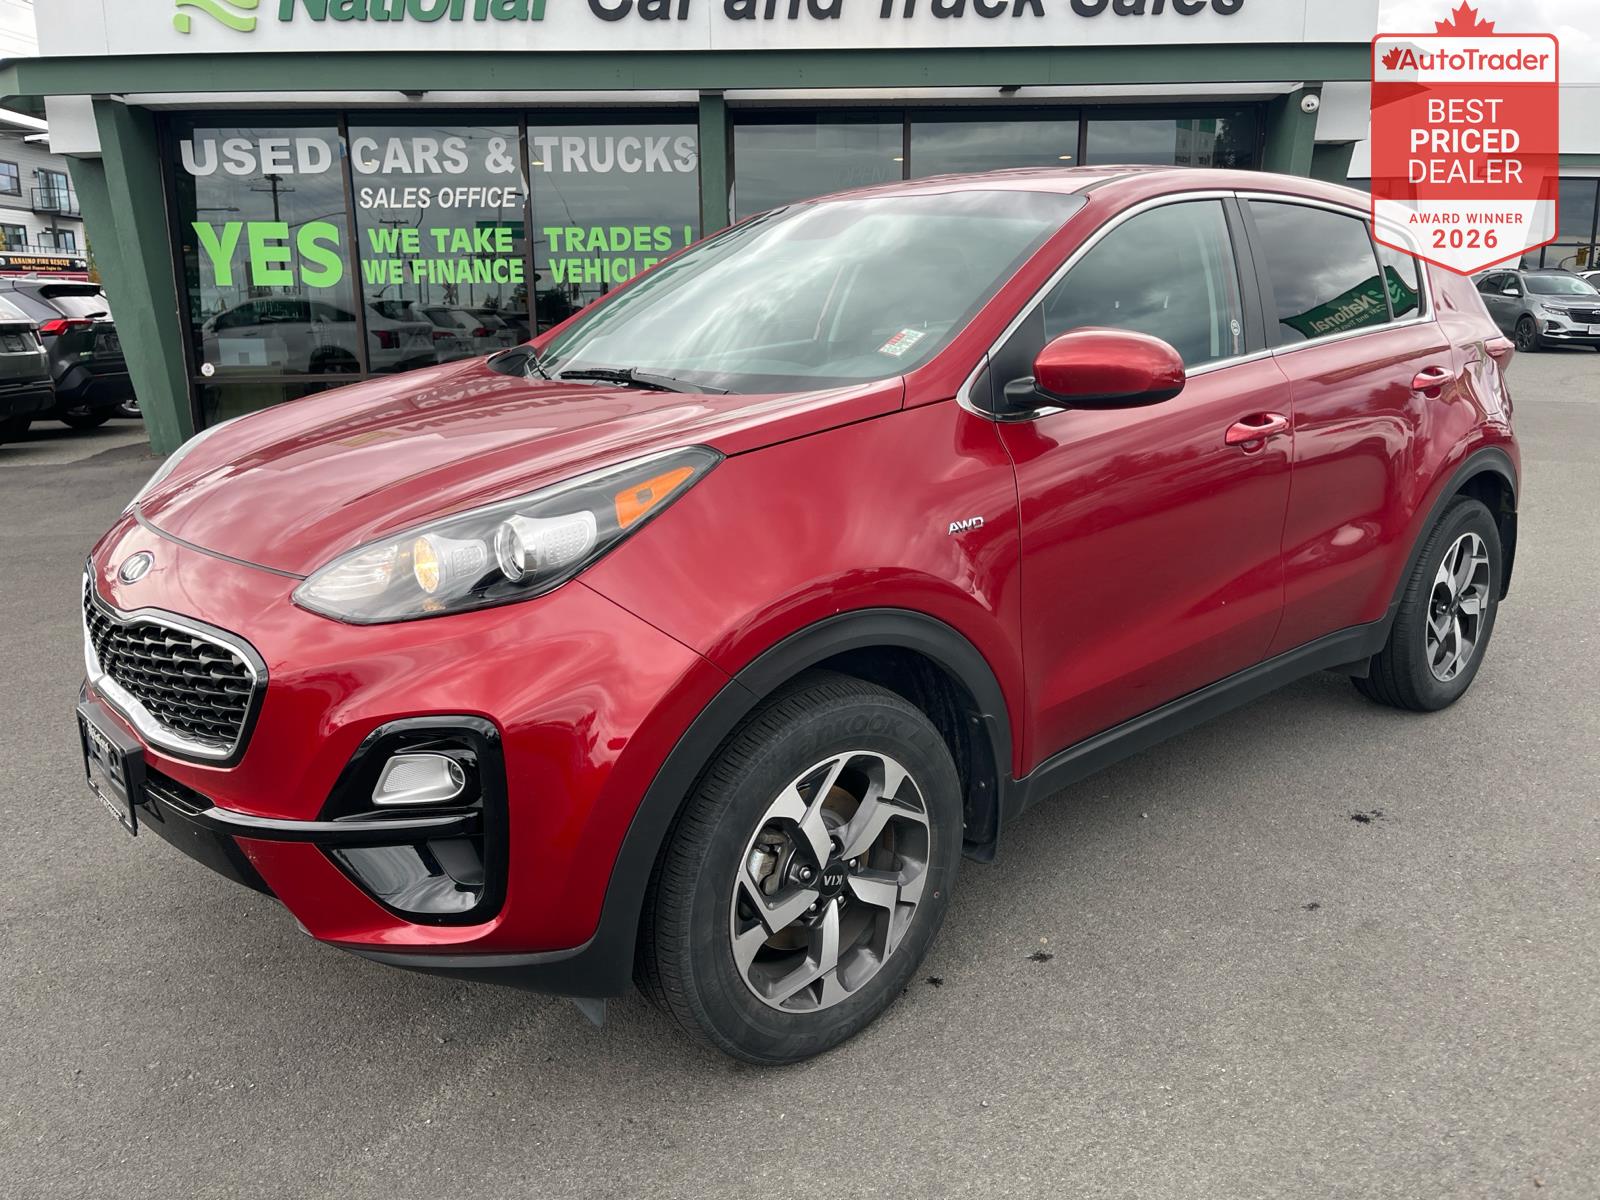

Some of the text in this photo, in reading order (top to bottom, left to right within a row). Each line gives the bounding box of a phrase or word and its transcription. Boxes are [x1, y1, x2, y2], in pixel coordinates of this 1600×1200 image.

[180, 136, 698, 176] USED CARS & TRUCKS
[359, 187, 517, 209] SALES OFFICE
[368, 228, 421, 254] WE
[430, 227, 513, 253] TAKE
[543, 226, 672, 252] TRADES
[191, 221, 344, 288] YES
[362, 259, 404, 285] WE
[412, 258, 524, 284] FINANCE
[948, 516, 984, 536] AWD
[824, 874, 843, 886] KIA
